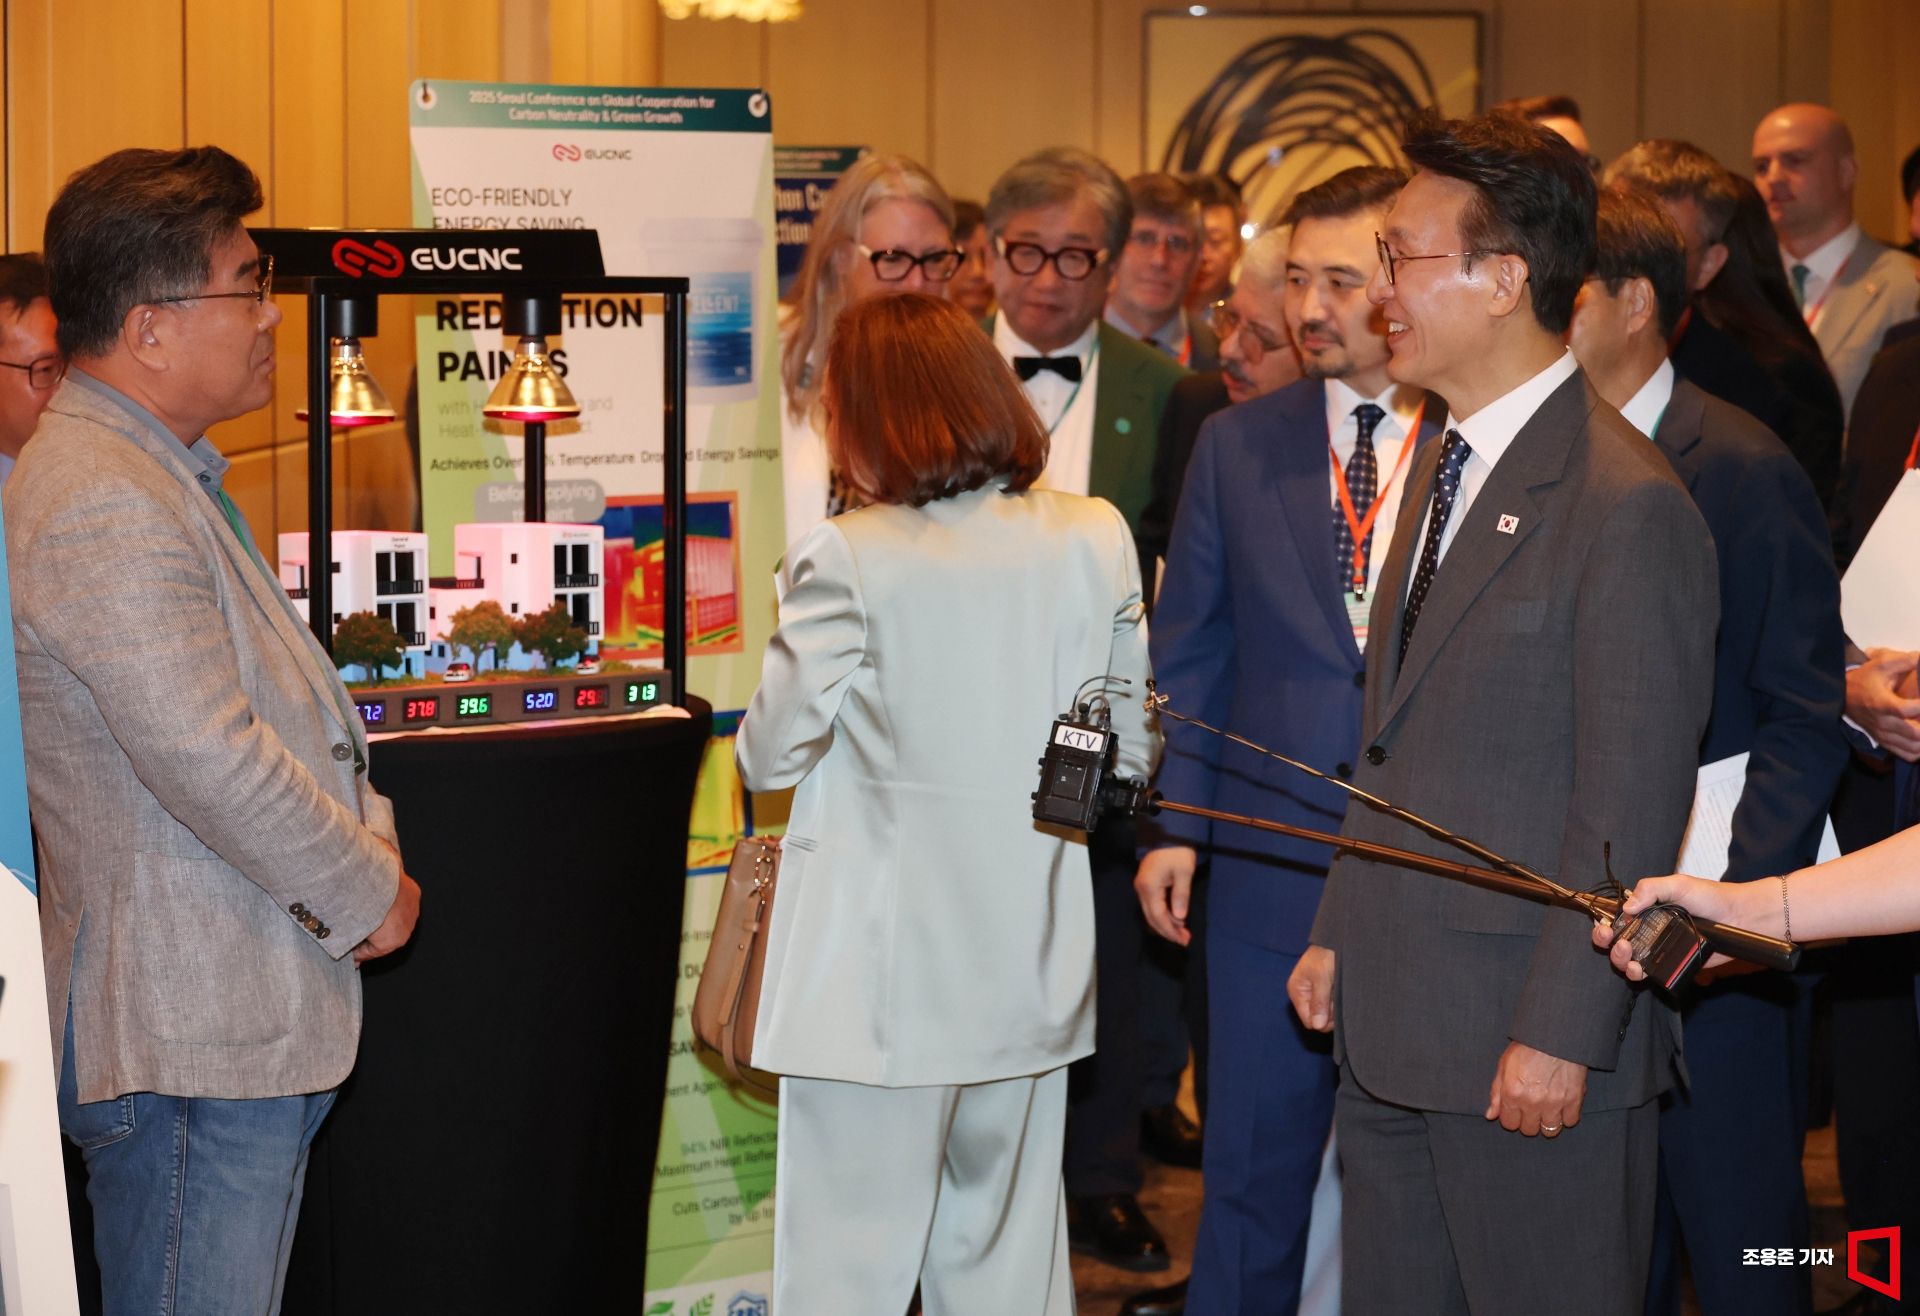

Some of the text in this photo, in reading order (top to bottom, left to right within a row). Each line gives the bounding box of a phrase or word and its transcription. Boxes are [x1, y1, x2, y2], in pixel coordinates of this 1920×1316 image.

[496, 91, 526, 105] Seoul
[527, 92, 585, 106] Conference
[587, 96, 601, 107] on
[602, 94, 635, 107] Global
[635, 94, 698, 109] Cooperation
[508, 107, 547, 121] Carbon
[547, 108, 600, 123] Neutrality
[611, 110, 643, 123] Green
[643, 110, 684, 124] Growth
[431, 187, 573, 207] ECO-FRIENDLY
[515, 216, 586, 230] SAVING
[411, 247, 523, 270] EUCNC
[436, 298, 643, 331] REDTION
[437, 349, 569, 382] PAIS
[430, 457, 489, 472] Achieves
[560, 452, 635, 468] Temperature
[696, 449, 734, 463] Energy
[738, 446, 779, 461] Savings
[1062, 729, 1097, 749] KTV
[672, 1201, 700, 1216] Cuts
[701, 1195, 744, 1211] Carbon
